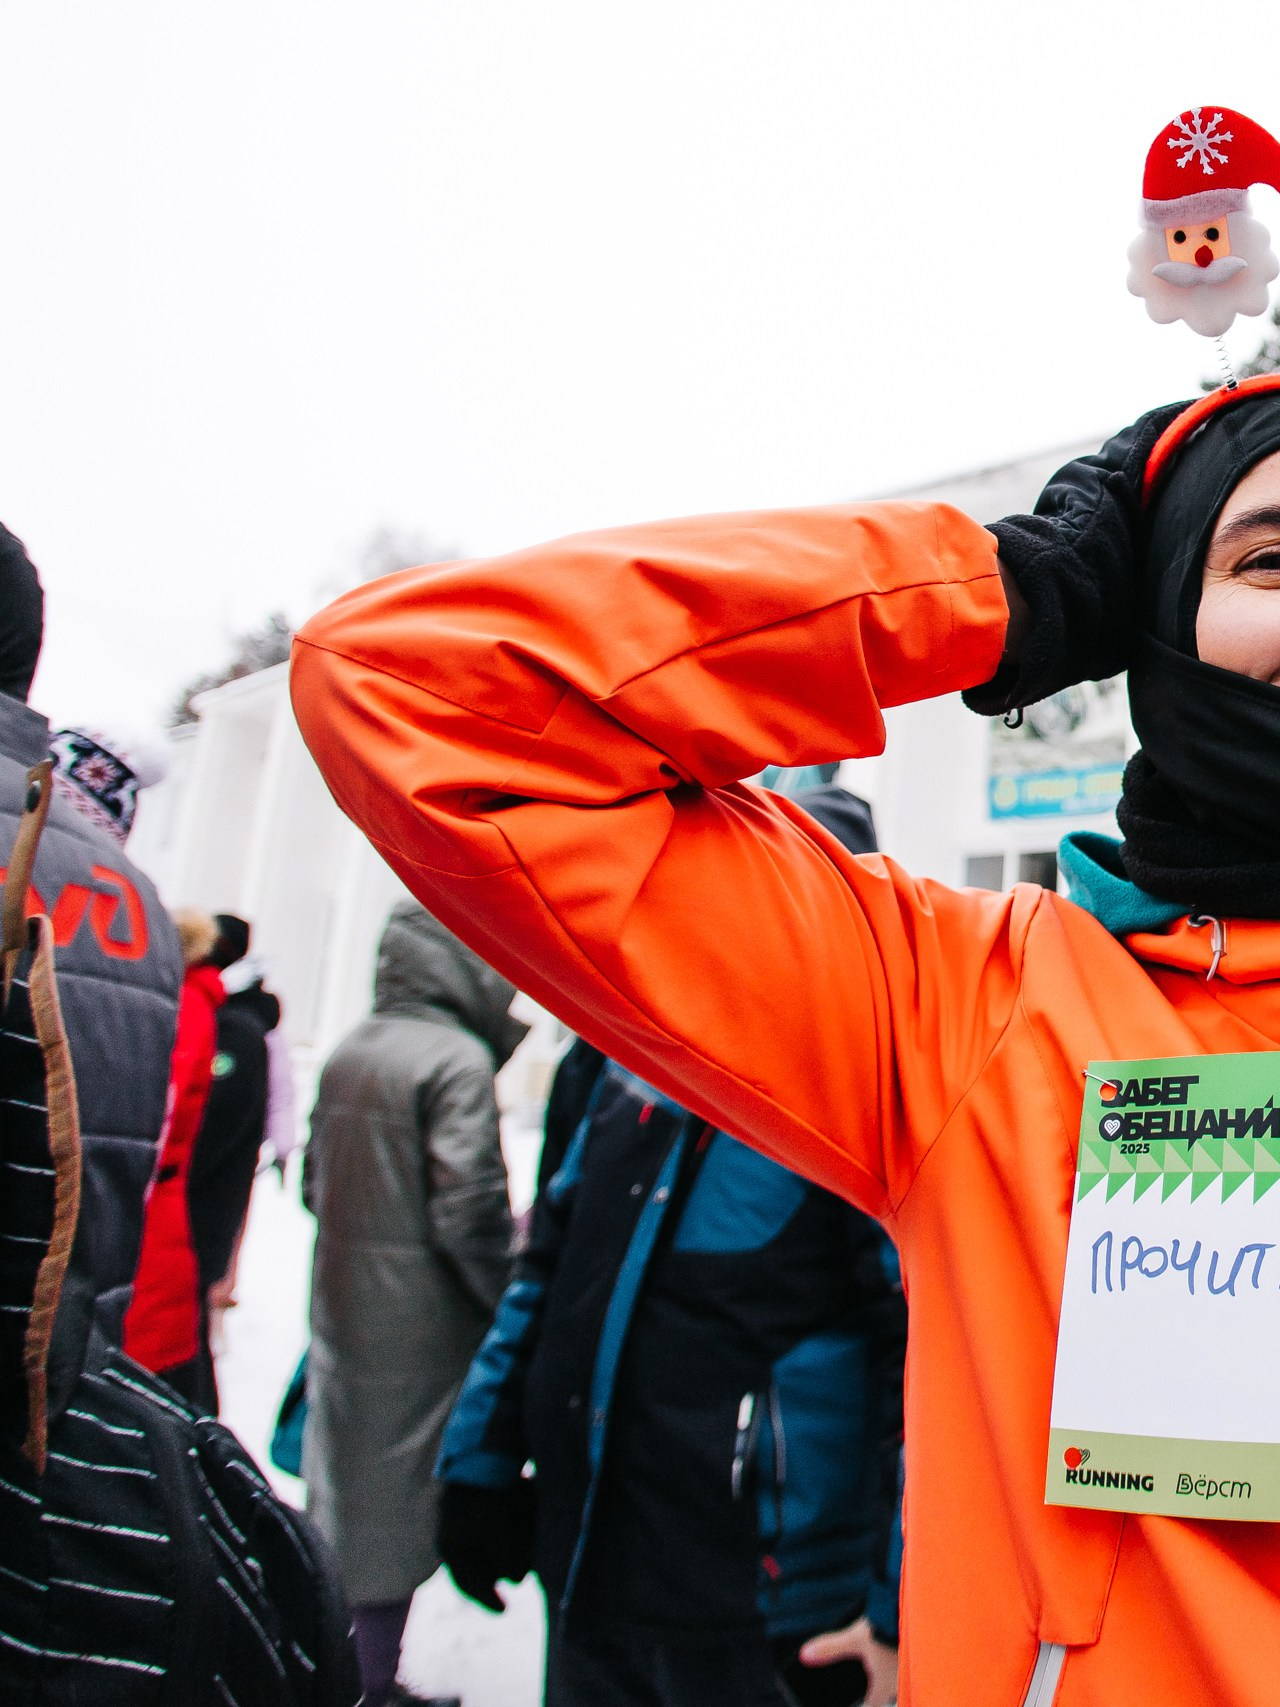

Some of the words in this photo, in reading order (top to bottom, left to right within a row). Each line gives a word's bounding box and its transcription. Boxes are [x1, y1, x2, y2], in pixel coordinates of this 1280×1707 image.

[1101, 1075, 1200, 1107] ЗАБЕГ
[1099, 1095, 1280, 1152] ОБЕЩАНИЙ
[1120, 1143, 1150, 1154] 2025
[1065, 1468, 1154, 1492] RUNNING
